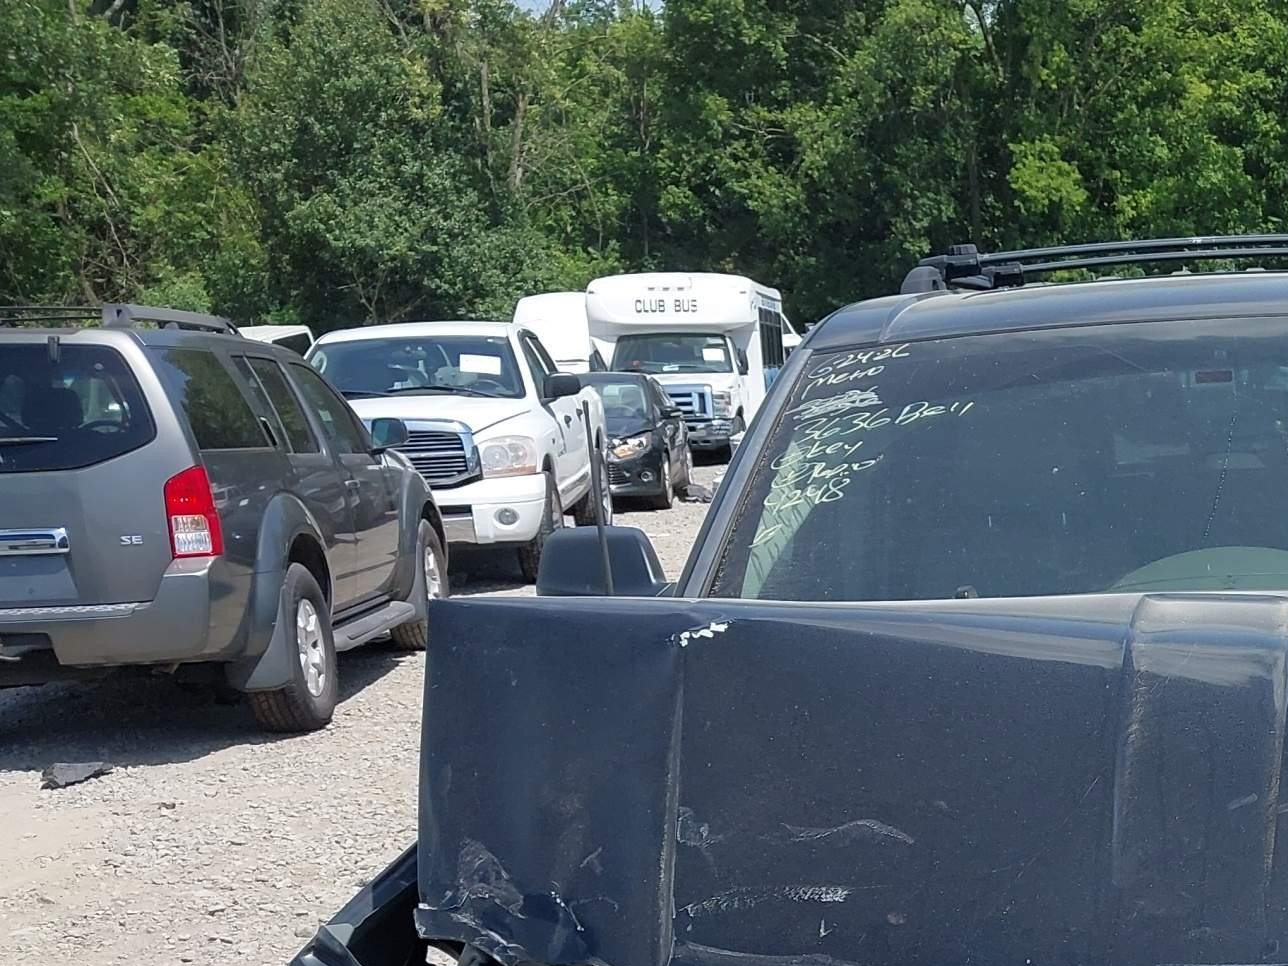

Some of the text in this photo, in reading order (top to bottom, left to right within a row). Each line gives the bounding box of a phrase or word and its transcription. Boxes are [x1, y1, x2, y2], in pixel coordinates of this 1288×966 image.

[635, 300, 698, 313] CLUB BUS
[793, 408, 891, 446] 3636
[120, 535, 143, 545] SE
